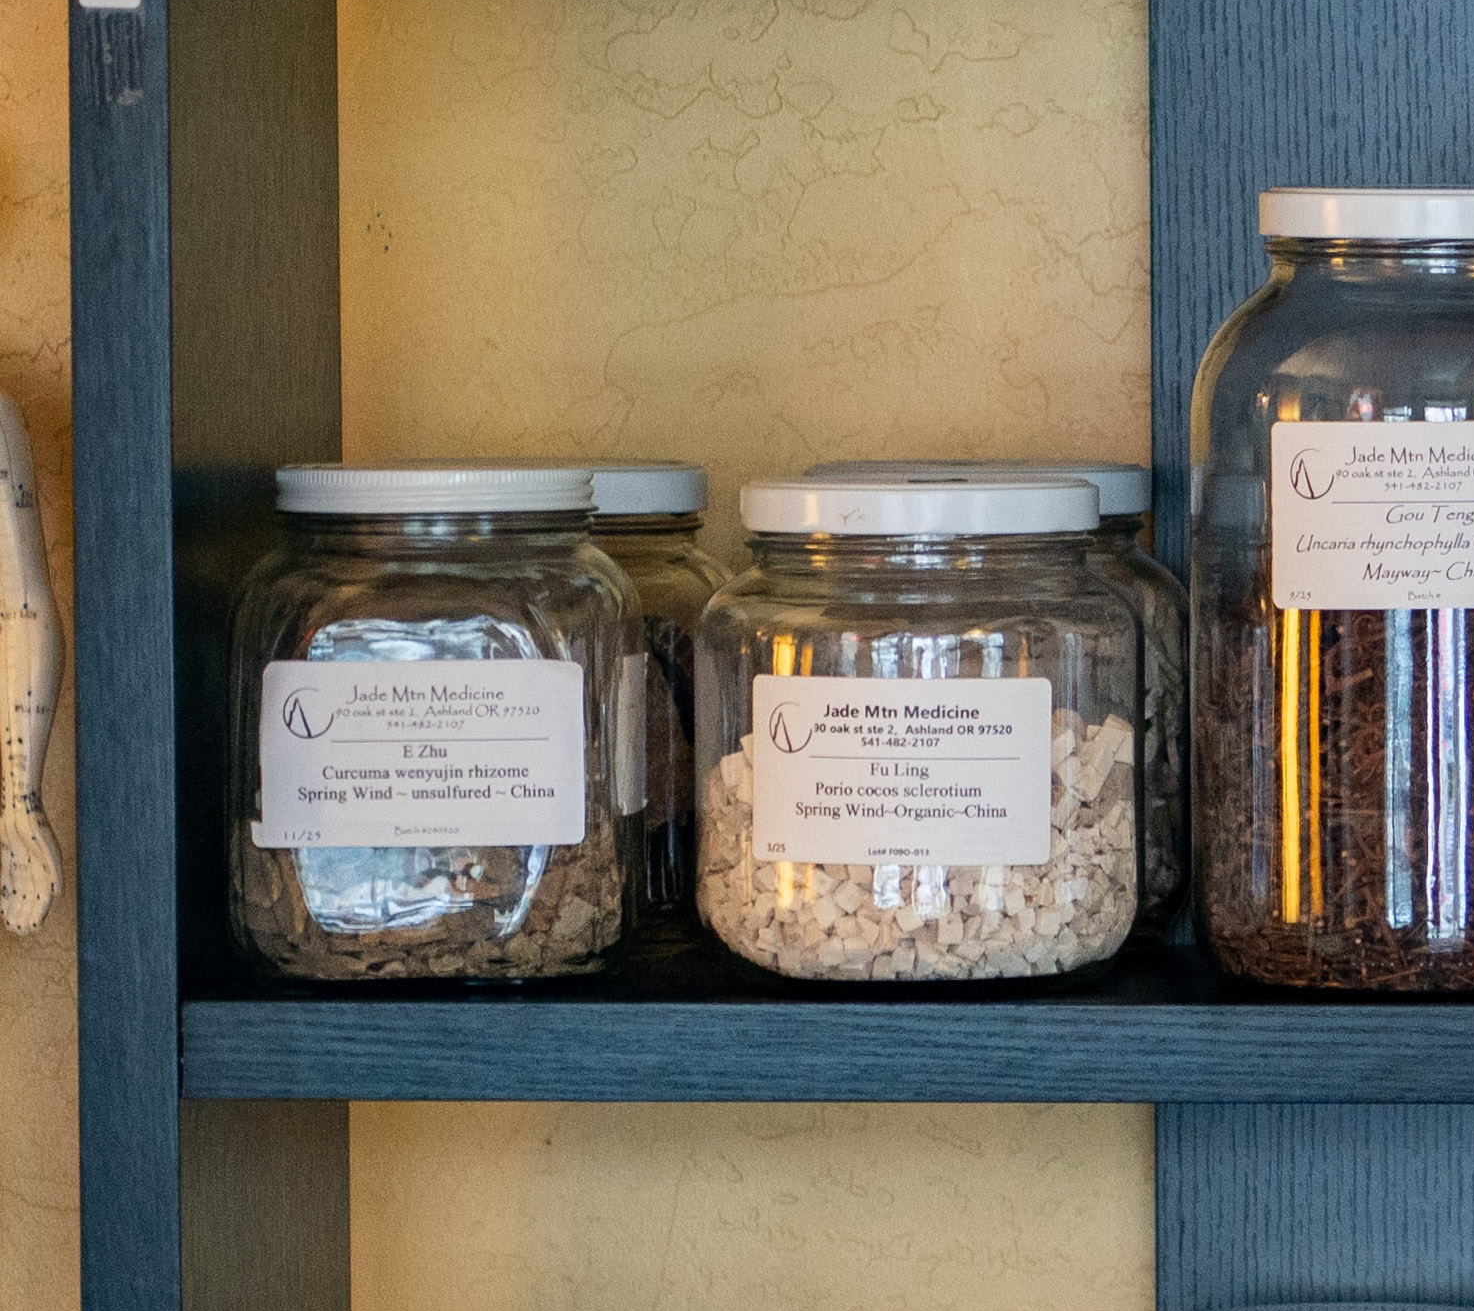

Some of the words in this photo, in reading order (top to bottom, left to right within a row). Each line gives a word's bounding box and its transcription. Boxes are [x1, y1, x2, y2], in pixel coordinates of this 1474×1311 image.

[1386, 505, 1424, 524] Gou
[403, 745, 412, 758] E
[418, 745, 447, 758] Zhu
[322, 766, 390, 780] Curcuma
[395, 769, 463, 782] wenyujin
[469, 765, 528, 778] rhizome
[871, 763, 888, 776] Fu
[895, 763, 929, 780] Ling
